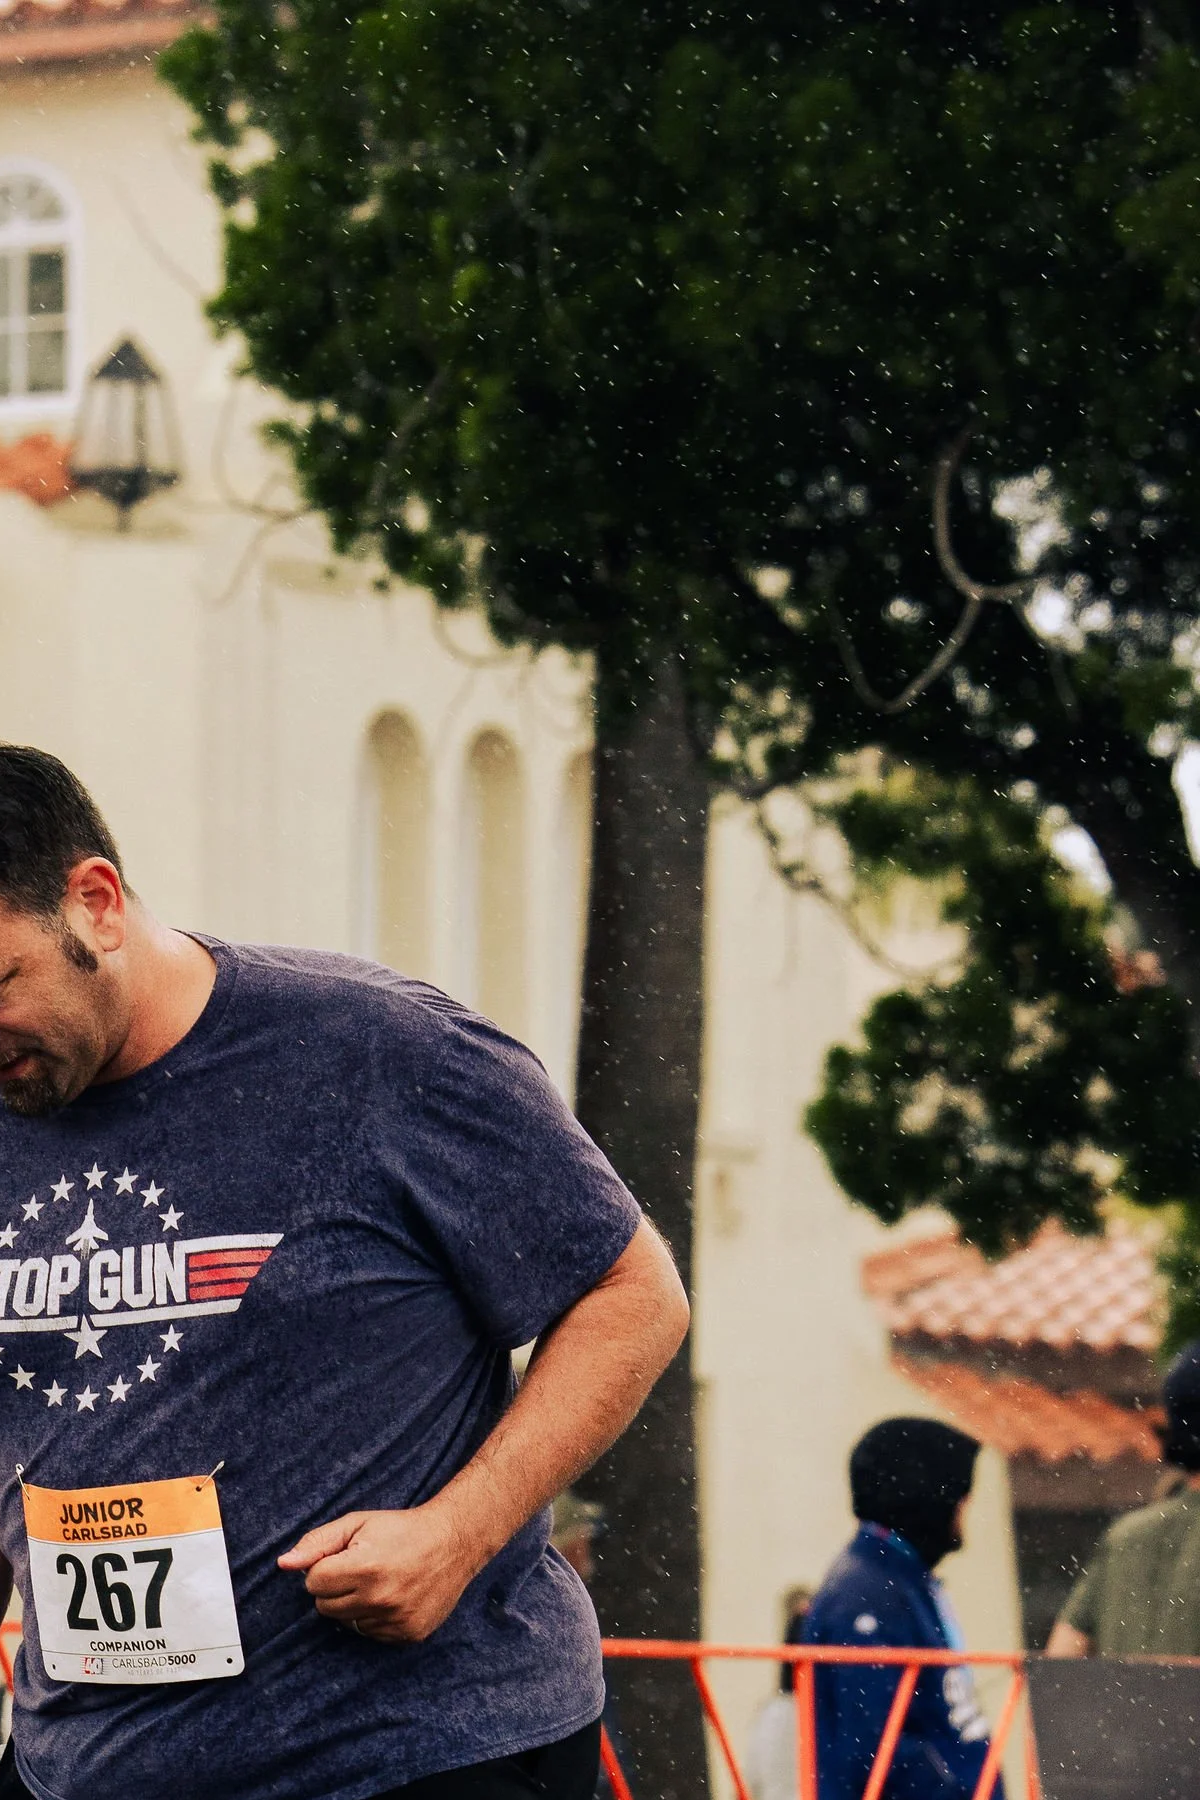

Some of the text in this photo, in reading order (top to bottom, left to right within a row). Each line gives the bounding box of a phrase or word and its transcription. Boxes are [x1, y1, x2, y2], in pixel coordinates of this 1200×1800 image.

[88, 1241, 188, 1312] GUN
[60, 1497, 145, 1525] JUNIOR
[62, 1523, 148, 1541] CARLSBAD
[56, 1547, 174, 1633] 267
[90, 1638, 167, 1652] COMPANION
